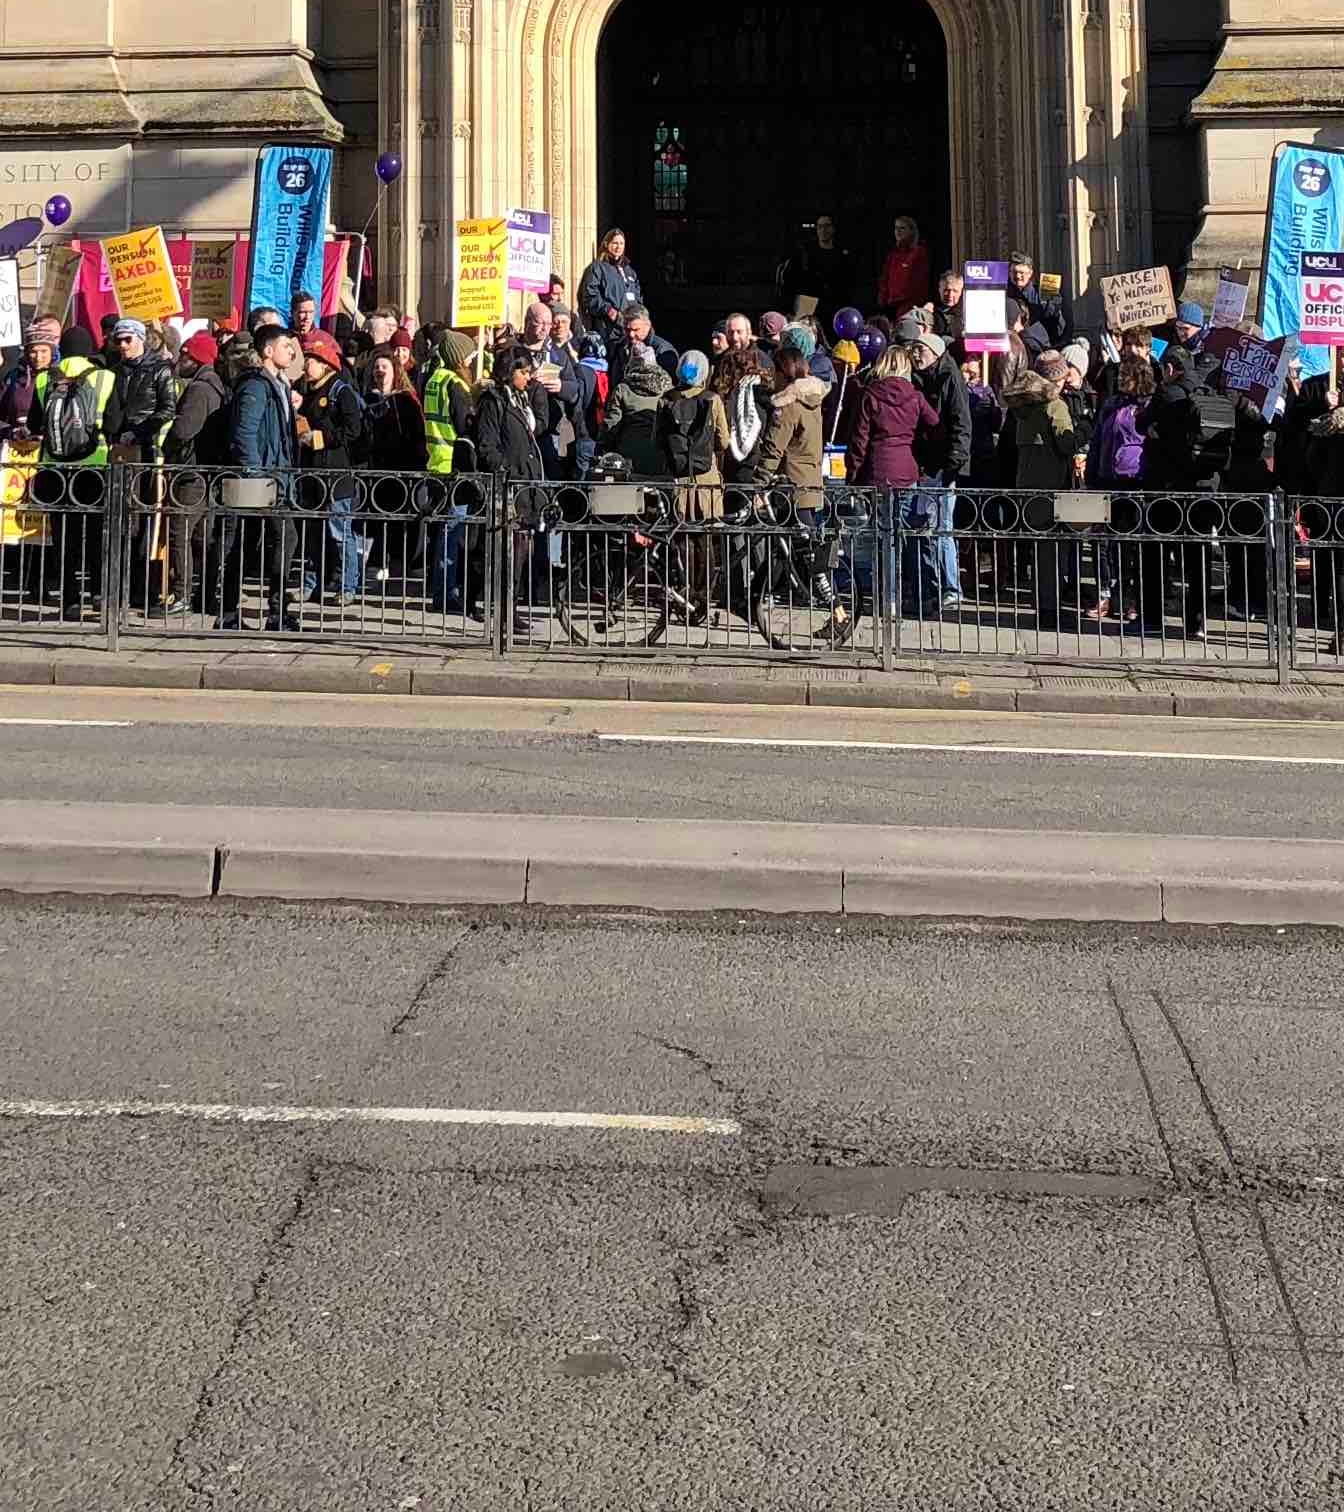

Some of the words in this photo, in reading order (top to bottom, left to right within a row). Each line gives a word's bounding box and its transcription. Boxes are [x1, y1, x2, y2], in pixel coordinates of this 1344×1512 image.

[74, 162, 111, 182] OF
[285, 172, 305, 188] 26
[1300, 174, 1321, 191] 26
[459, 226, 479, 234] OUR
[1310, 207, 1329, 249] Wills
[269, 202, 293, 276] Building
[107, 242, 129, 255] OUR
[109, 248, 156, 265] PENSION
[460, 243, 480, 253] OUR
[460, 252, 502, 263] PENSION
[114, 260, 163, 282] AXED.
[459, 266, 502, 281] AXED.
[1110, 268, 1157, 289] ARISE!
[1119, 303, 1168, 324] UNIVERSITY
